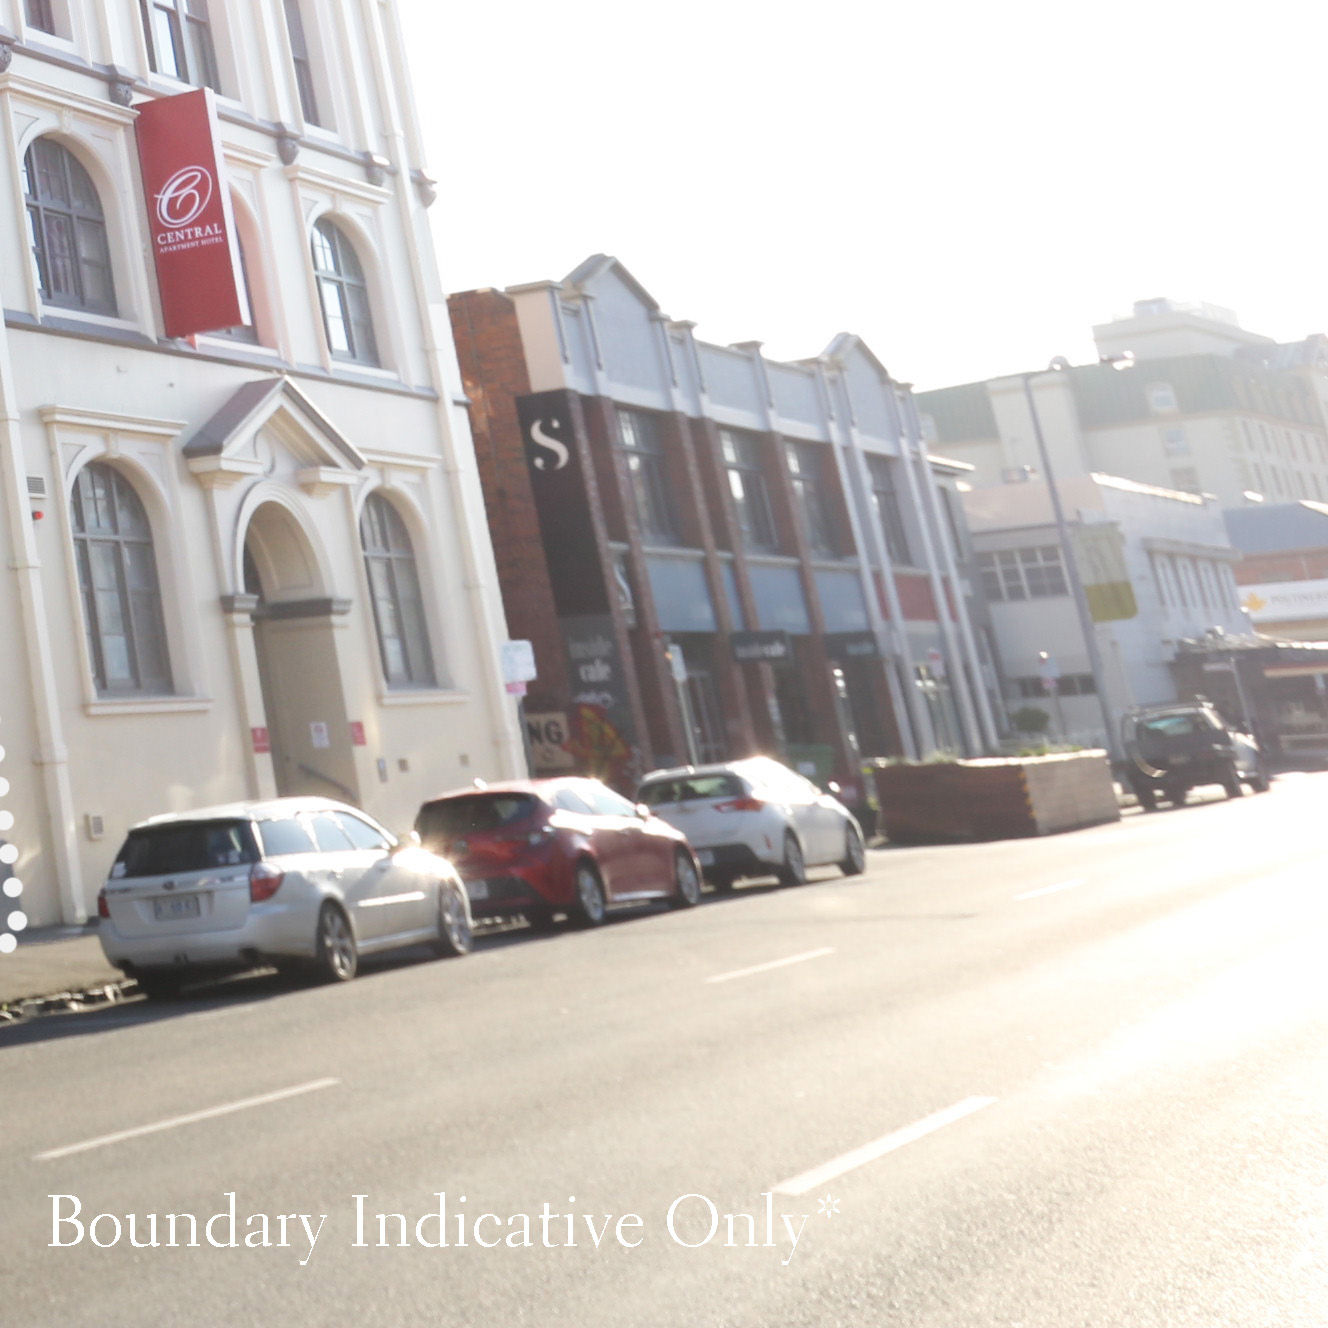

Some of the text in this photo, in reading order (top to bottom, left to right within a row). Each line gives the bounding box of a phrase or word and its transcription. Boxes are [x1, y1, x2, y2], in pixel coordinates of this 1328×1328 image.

[157, 223, 223, 245] CENTRAL
[159, 237, 224, 253] APARTMENT HOTEL
